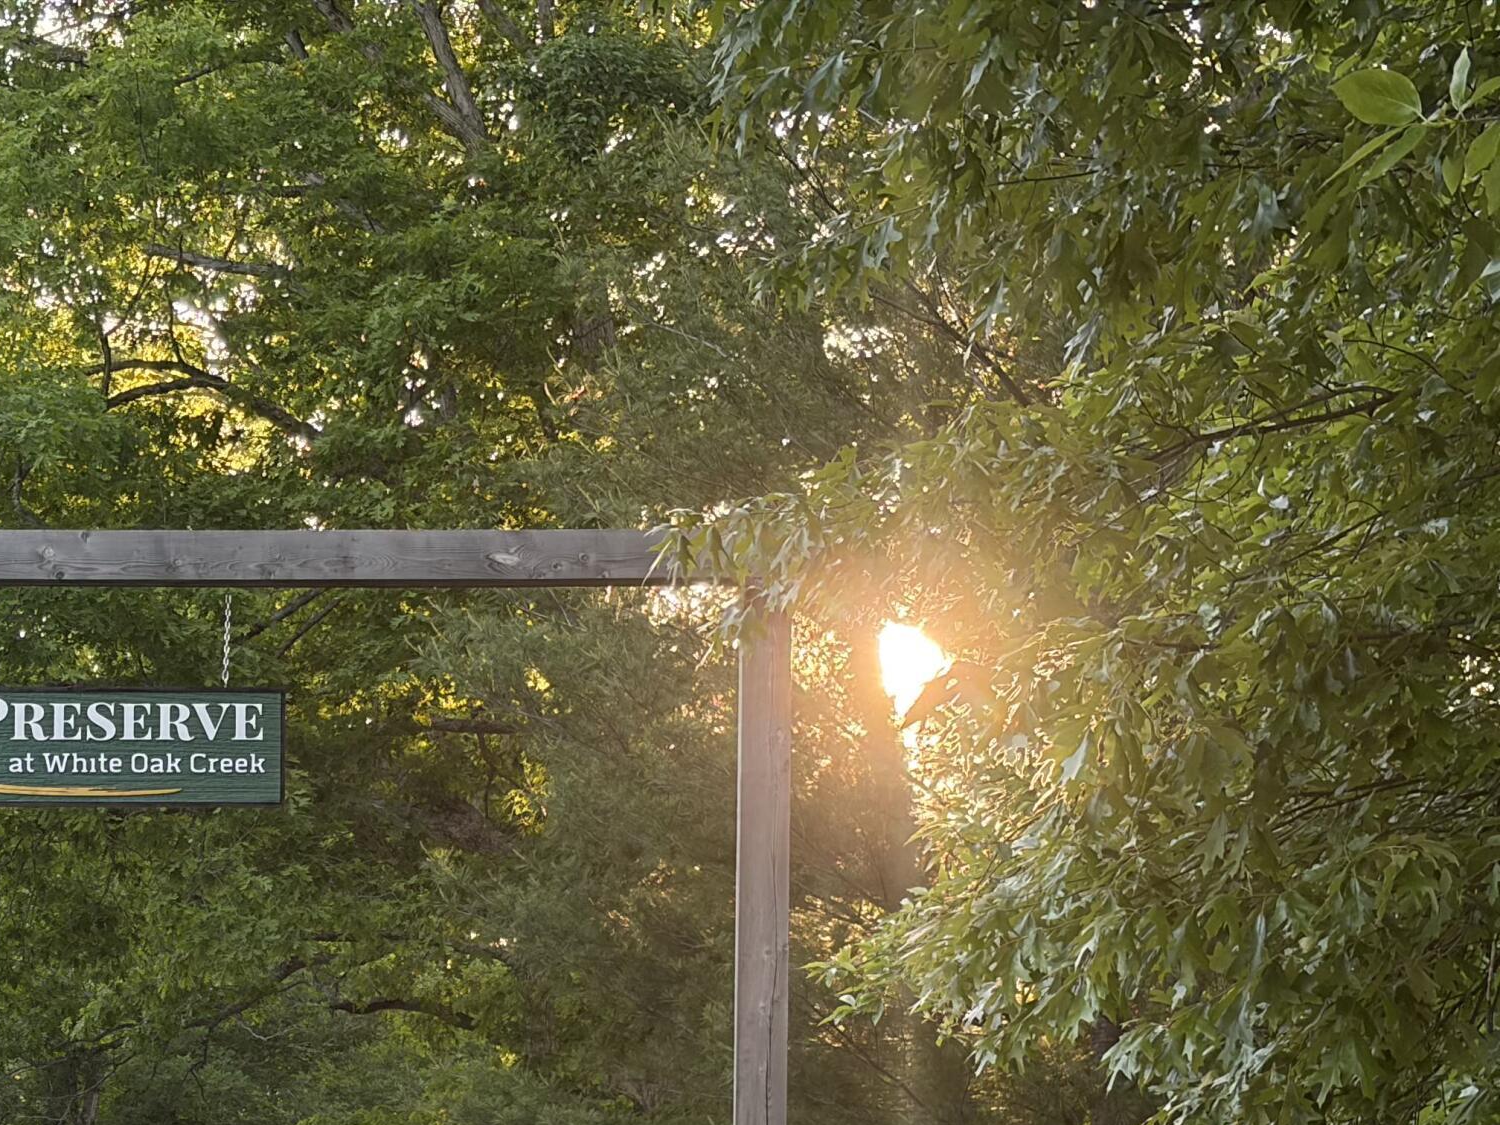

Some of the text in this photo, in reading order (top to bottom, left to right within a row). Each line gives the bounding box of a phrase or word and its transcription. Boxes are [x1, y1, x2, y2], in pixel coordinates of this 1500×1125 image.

[8, 752, 266, 774] at White Oak Creek
